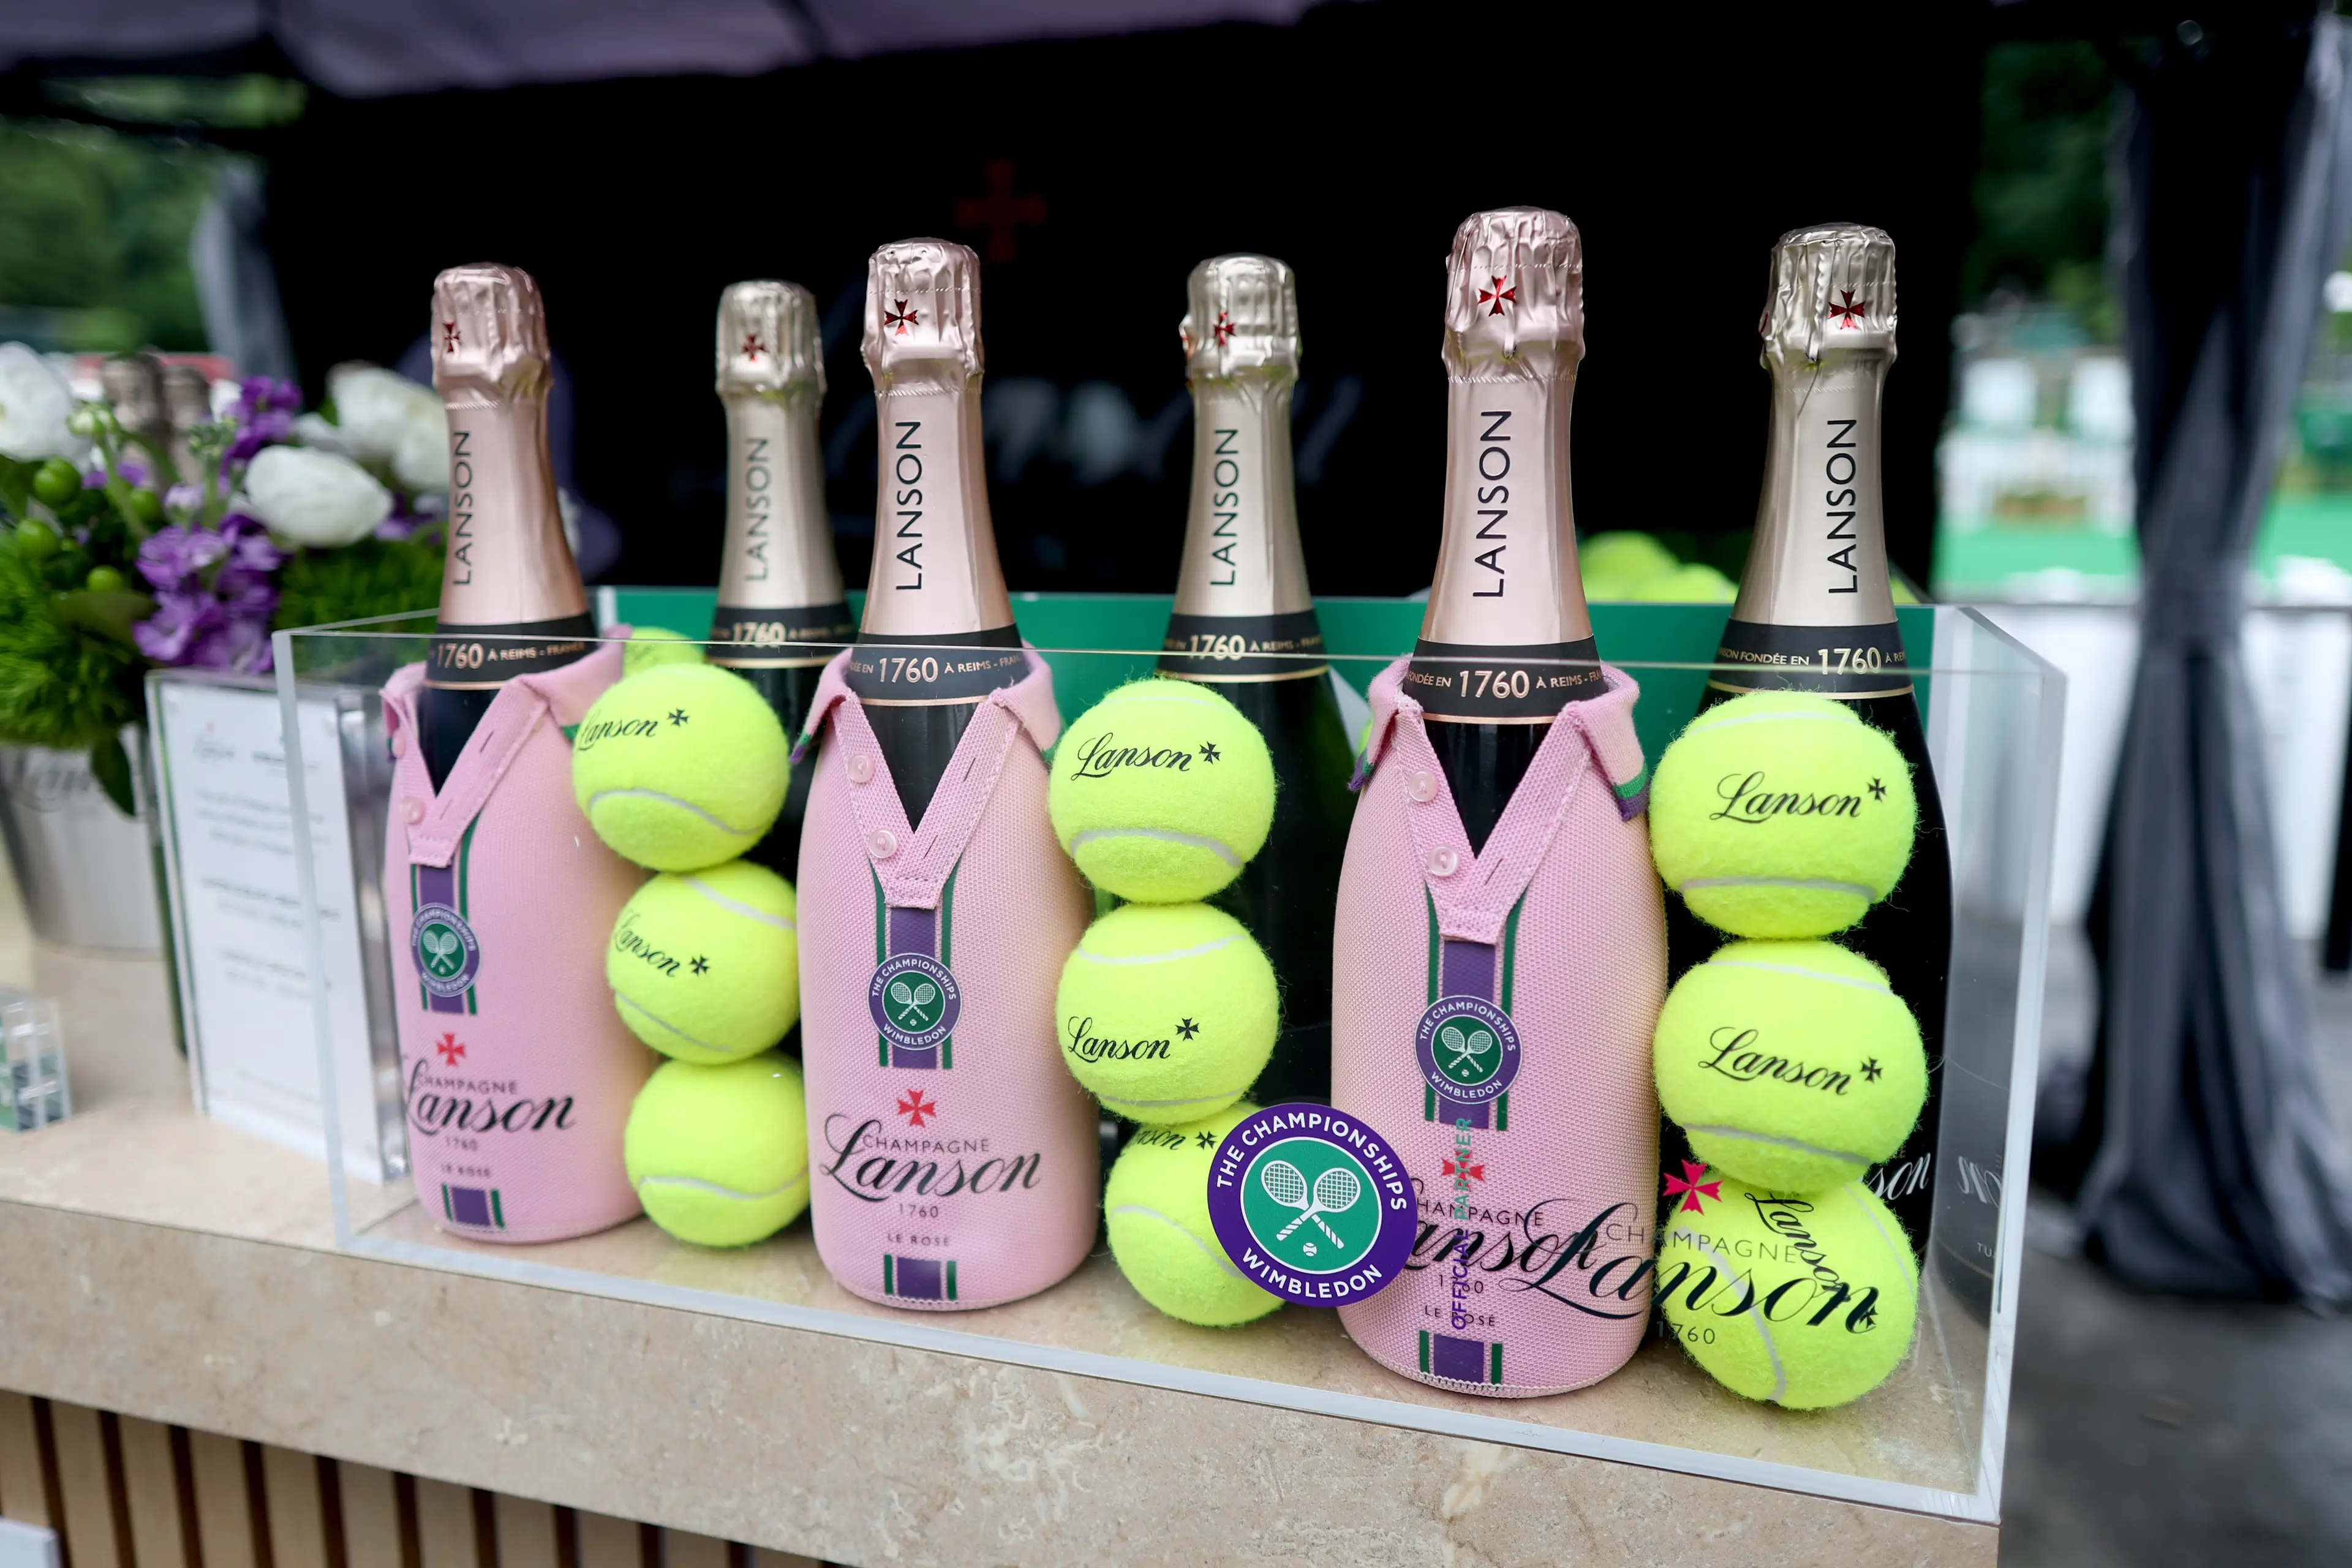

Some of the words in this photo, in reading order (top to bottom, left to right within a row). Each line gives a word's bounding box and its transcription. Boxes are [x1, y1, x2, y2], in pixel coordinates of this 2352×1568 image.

[453, 431, 473, 586] LANSON
[745, 437, 771, 582] LANSON
[895, 421, 923, 590] LANSON
[1210, 428, 1240, 587] LANSON
[1472, 410, 1512, 598] LANSON
[1825, 419, 1858, 594] LANSON
[437, 643, 484, 669] 1760
[732, 621, 786, 647] 1760
[1188, 634, 1246, 661] 1760
[862, 662, 874, 674] EN
[879, 657, 939, 684] 1760
[944, 662, 954, 674] À
[958, 660, 992, 673] REIMS
[1435, 677, 1452, 688] EN
[1460, 670, 1530, 698] 1760
[1536, 676, 1547, 689] À
[1550, 674, 1583, 688] REIMS
[1740, 652, 1787, 666] FONDÉE
[1790, 655, 1810, 666] EN
[1818, 646, 1882, 676] 1760
[1885, 651, 1893, 664] À
[576, 708, 659, 752] Lanson
[1070, 732, 1193, 781] Lanson
[1709, 771, 1862, 824] Lanson
[612, 908, 681, 979] Lanson
[872, 976, 884, 997] THE
[882, 959, 957, 1000] CHAMPIONSHIPS
[883, 1023, 946, 1045] WIMBLEDON
[1067, 1016, 1171, 1064] Lanson
[1420, 1017, 1434, 1040] THE
[1432, 1001, 1516, 1052] CHAMPIONSHIPS
[1431, 1071, 1502, 1099] WIMBLEDON
[1697, 1026, 1852, 1096] Lanson
[405, 1058, 577, 1136] Lanson
[819, 1113, 1041, 1202] Lanson
[861, 1133, 990, 1153] CHAMPAGNE
[1216, 1144, 1246, 1189] THE
[1241, 1113, 1408, 1212] CHAMPIONSHIPS
[1453, 1118, 1472, 1220] PARTNER
[898, 1203, 940, 1219] 1760
[1417, 1197, 1544, 1226] HAMPAGNE
[887, 1233, 903, 1243] LE
[1605, 1223, 1798, 1264] CHAMPAGNE
[1241, 1246, 1383, 1298] WIMBLEDON
[1451, 1229, 1469, 1330] OFFICIAL
[1498, 1199, 1879, 1334] Lanson
[1425, 1305, 1441, 1317] LE
[1656, 1320, 1716, 1345] 1760
